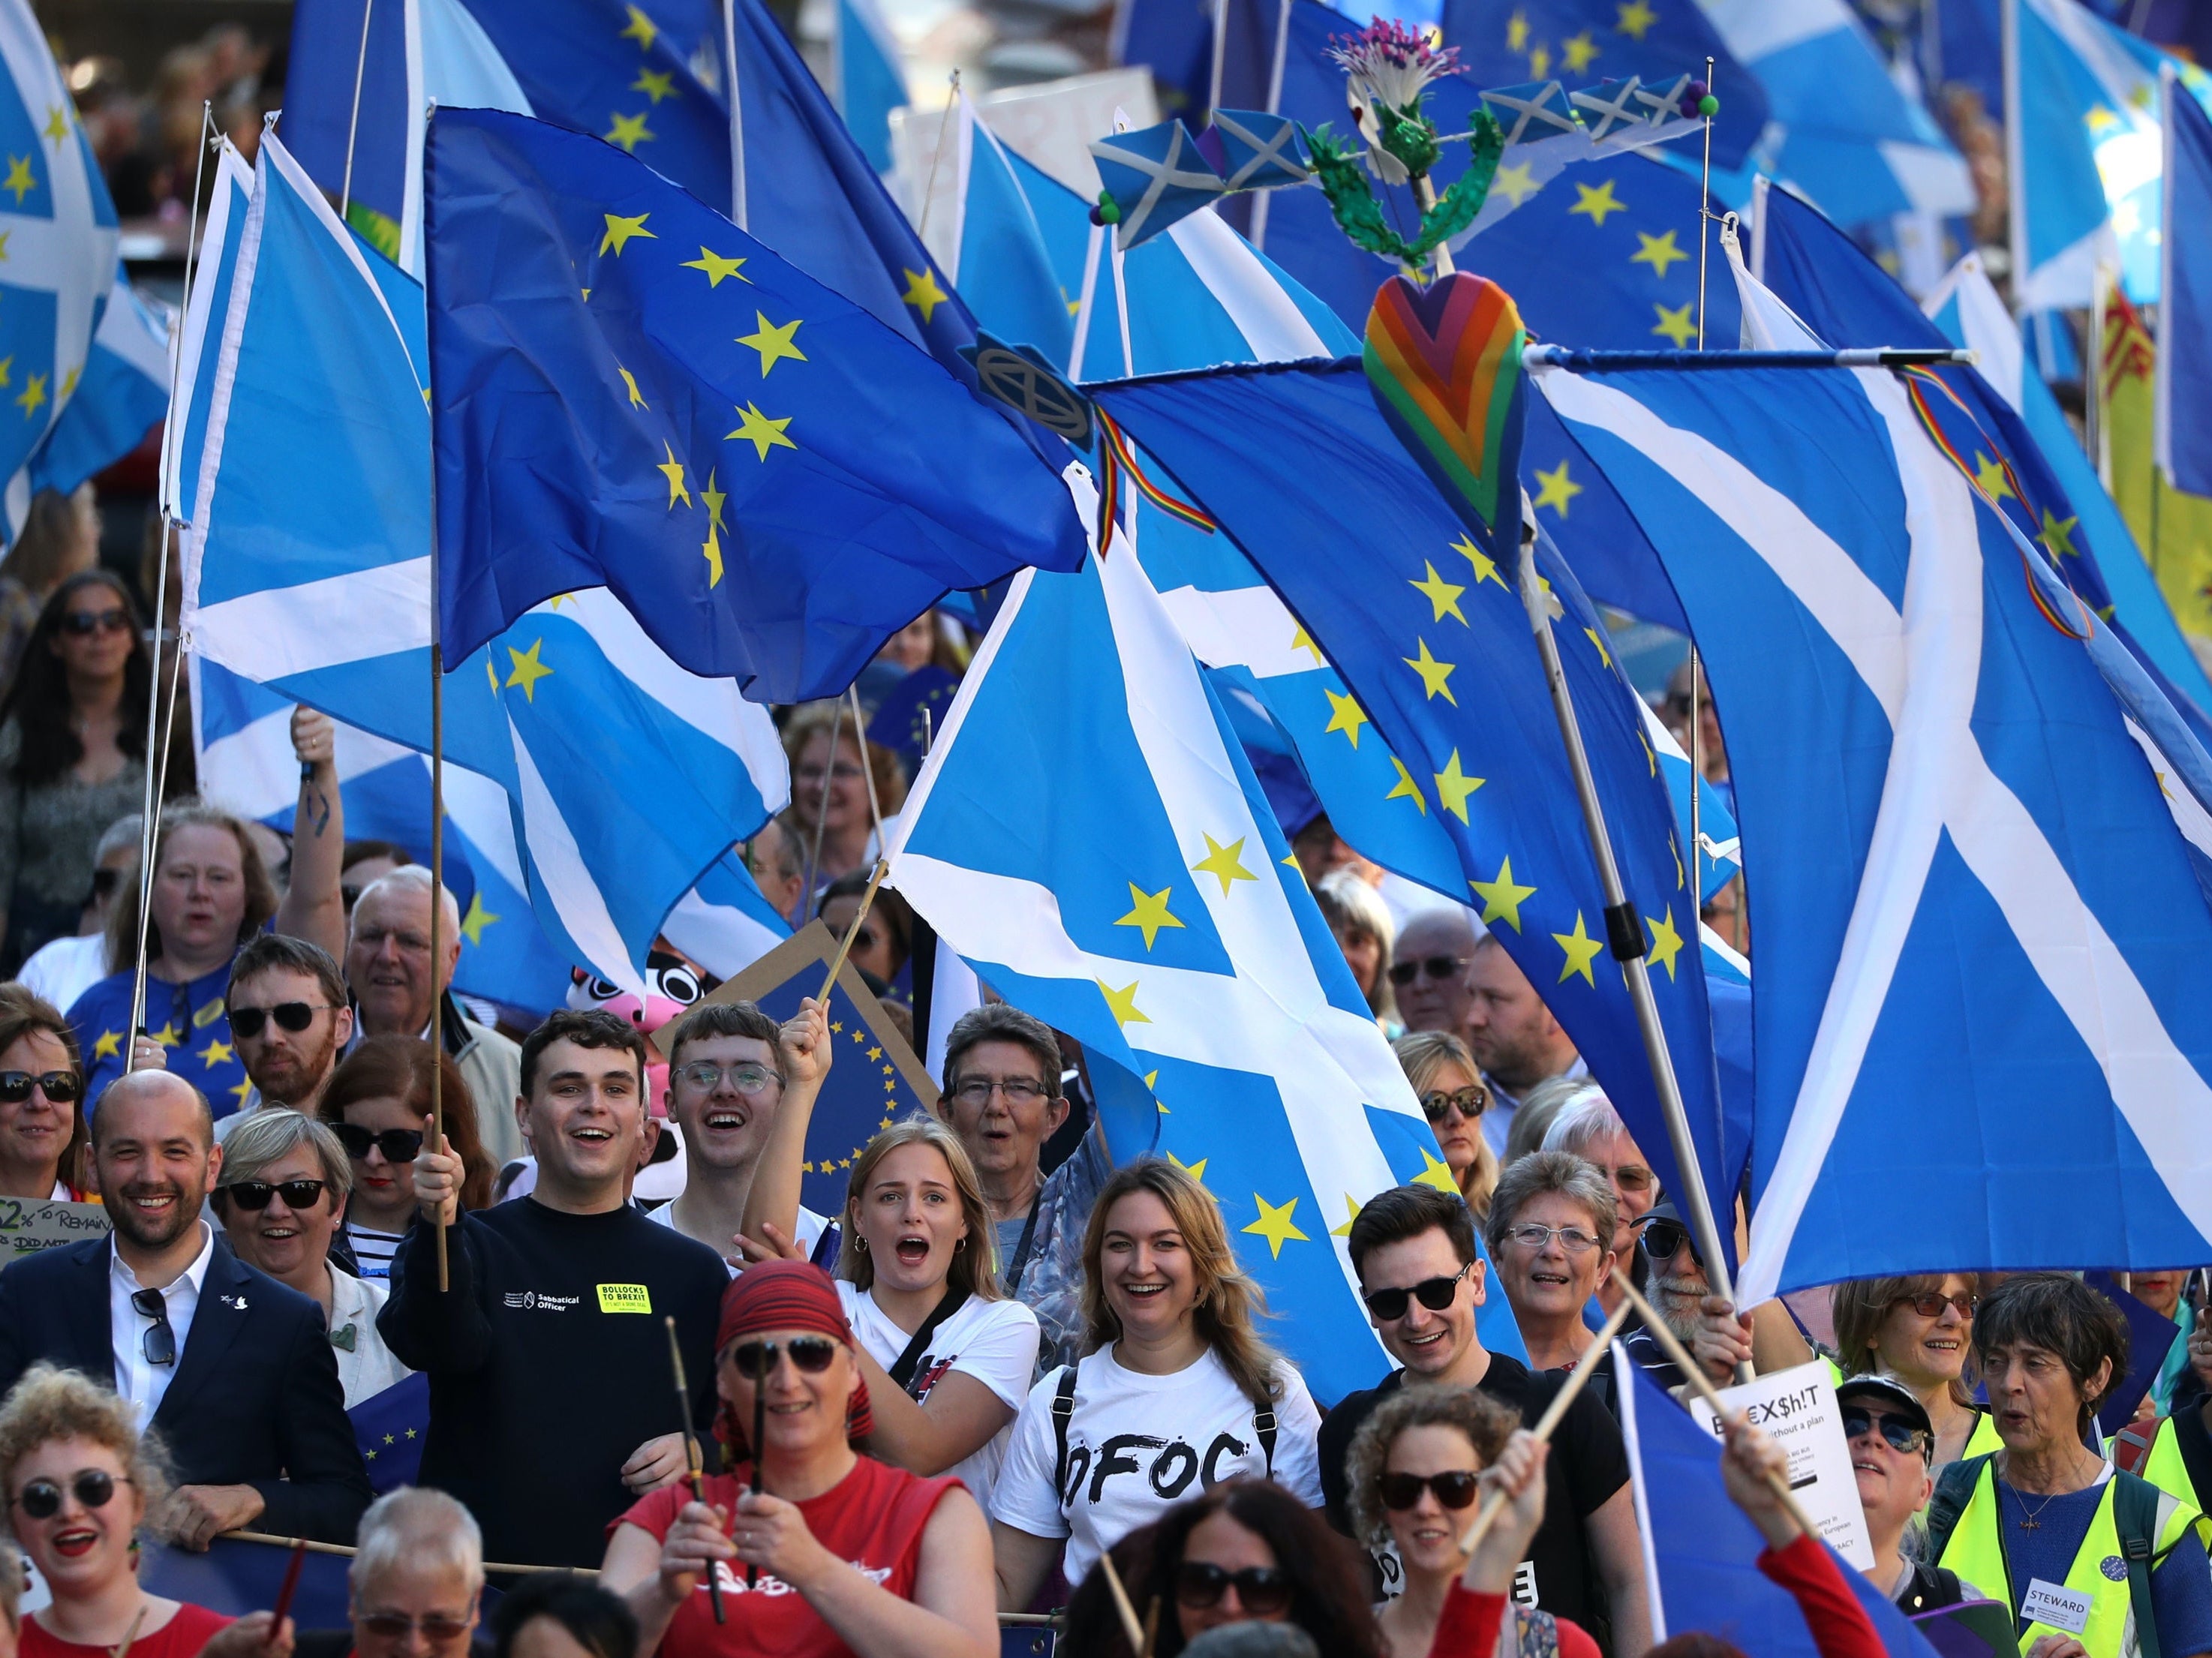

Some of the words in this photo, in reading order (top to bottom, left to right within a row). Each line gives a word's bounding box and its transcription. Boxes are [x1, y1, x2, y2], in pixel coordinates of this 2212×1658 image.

[603, 1286, 644, 1294] BOLLOCKS
[537, 1293, 579, 1304] Sabbatical
[537, 1301, 567, 1311] Officer
[1807, 1415, 1825, 1430] plan
[1824, 1521, 1852, 1535] European
[2030, 1590, 2084, 1613] STEWARD
